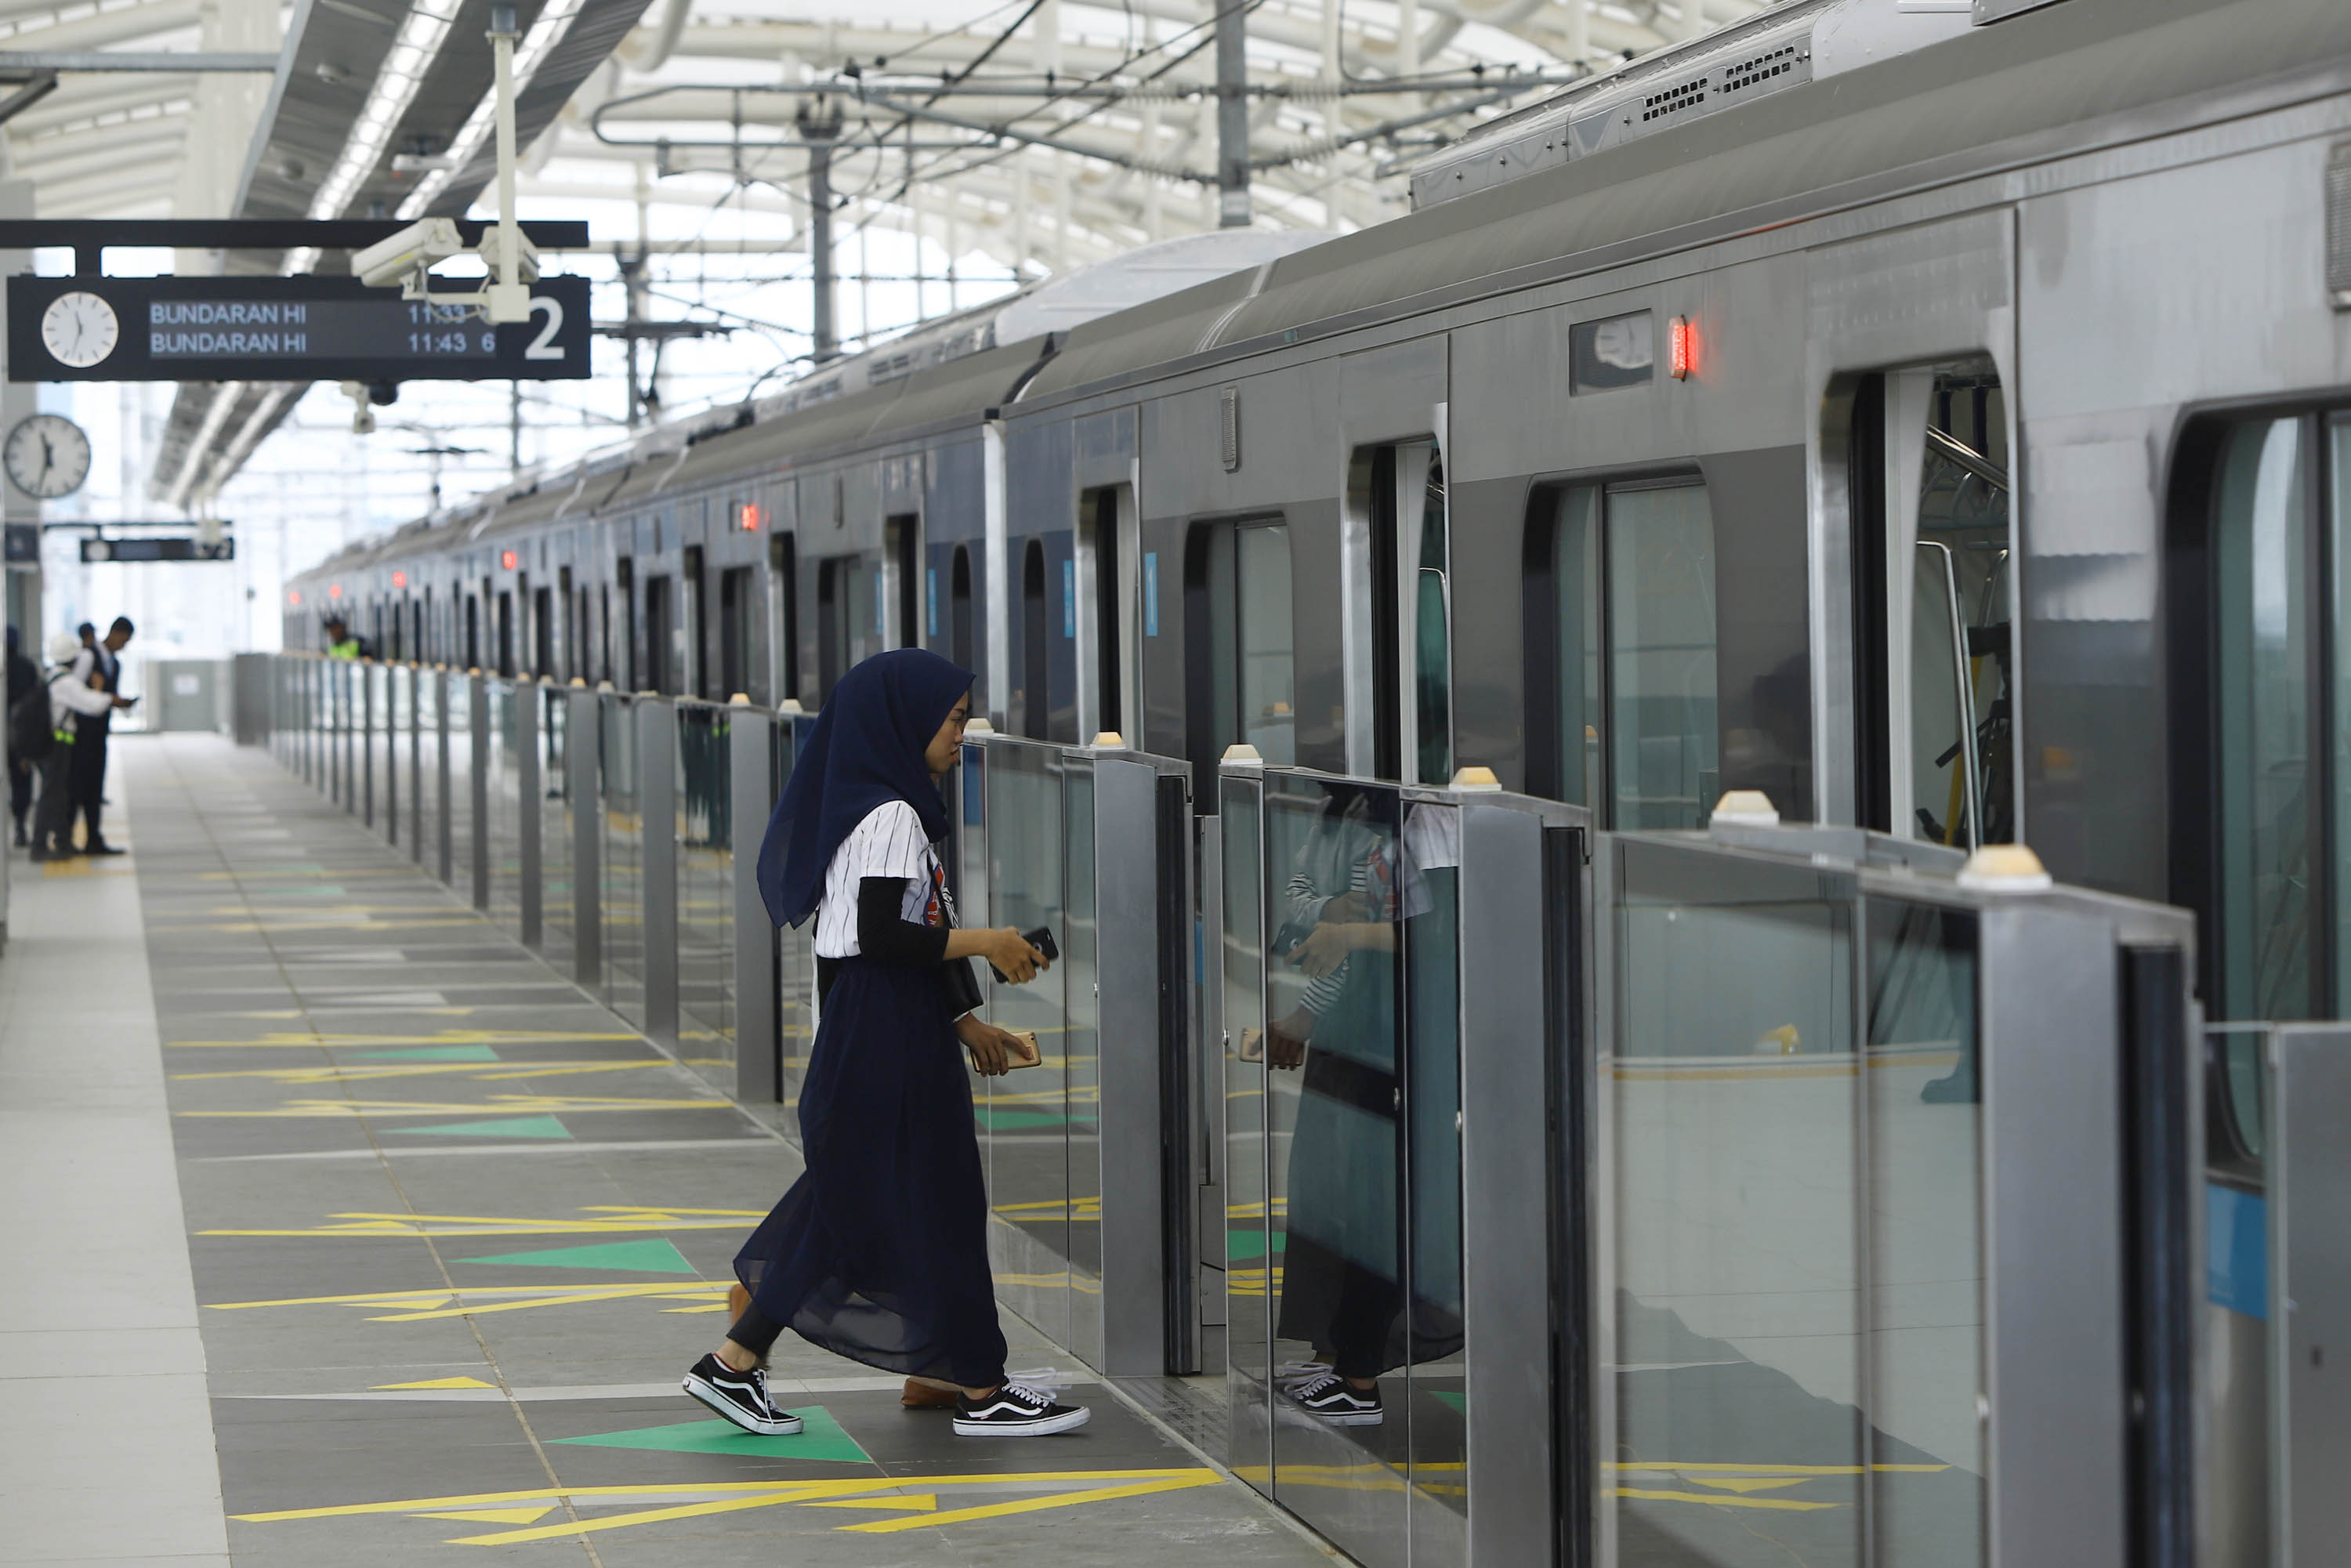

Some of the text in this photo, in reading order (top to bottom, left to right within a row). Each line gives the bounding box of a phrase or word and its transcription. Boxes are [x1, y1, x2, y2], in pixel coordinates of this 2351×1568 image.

[150, 303, 278, 324] BUNDARAN
[283, 303, 306, 324] HI
[524, 296, 565, 360] 2
[150, 331, 495, 353] BUNDARAN HI 11:43 6
